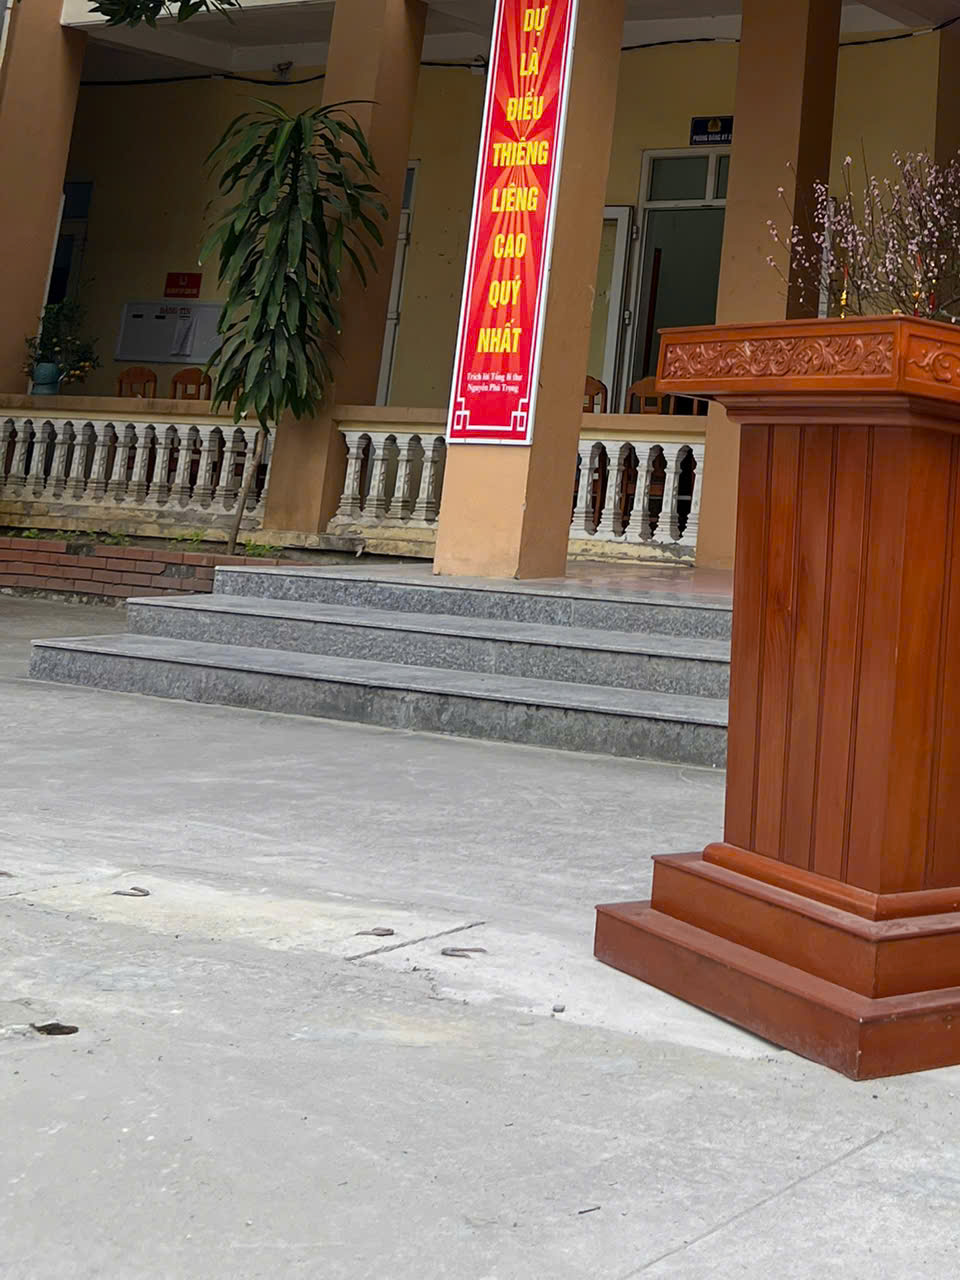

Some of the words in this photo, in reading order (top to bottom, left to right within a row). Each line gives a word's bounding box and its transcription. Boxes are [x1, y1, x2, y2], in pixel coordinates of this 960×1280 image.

[524, 5, 548, 35] DỰ
[520, 48, 538, 77] LÀ
[507, 88, 544, 121] ĐIỀU
[493, 137, 548, 166] THIÊNG
[492, 184, 538, 212] LIÊNG
[494, 233, 526, 259] CAO
[489, 275, 522, 308] QUÝ
[477, 319, 522, 353] NHẤT
[502, 384, 519, 394] Trọng
